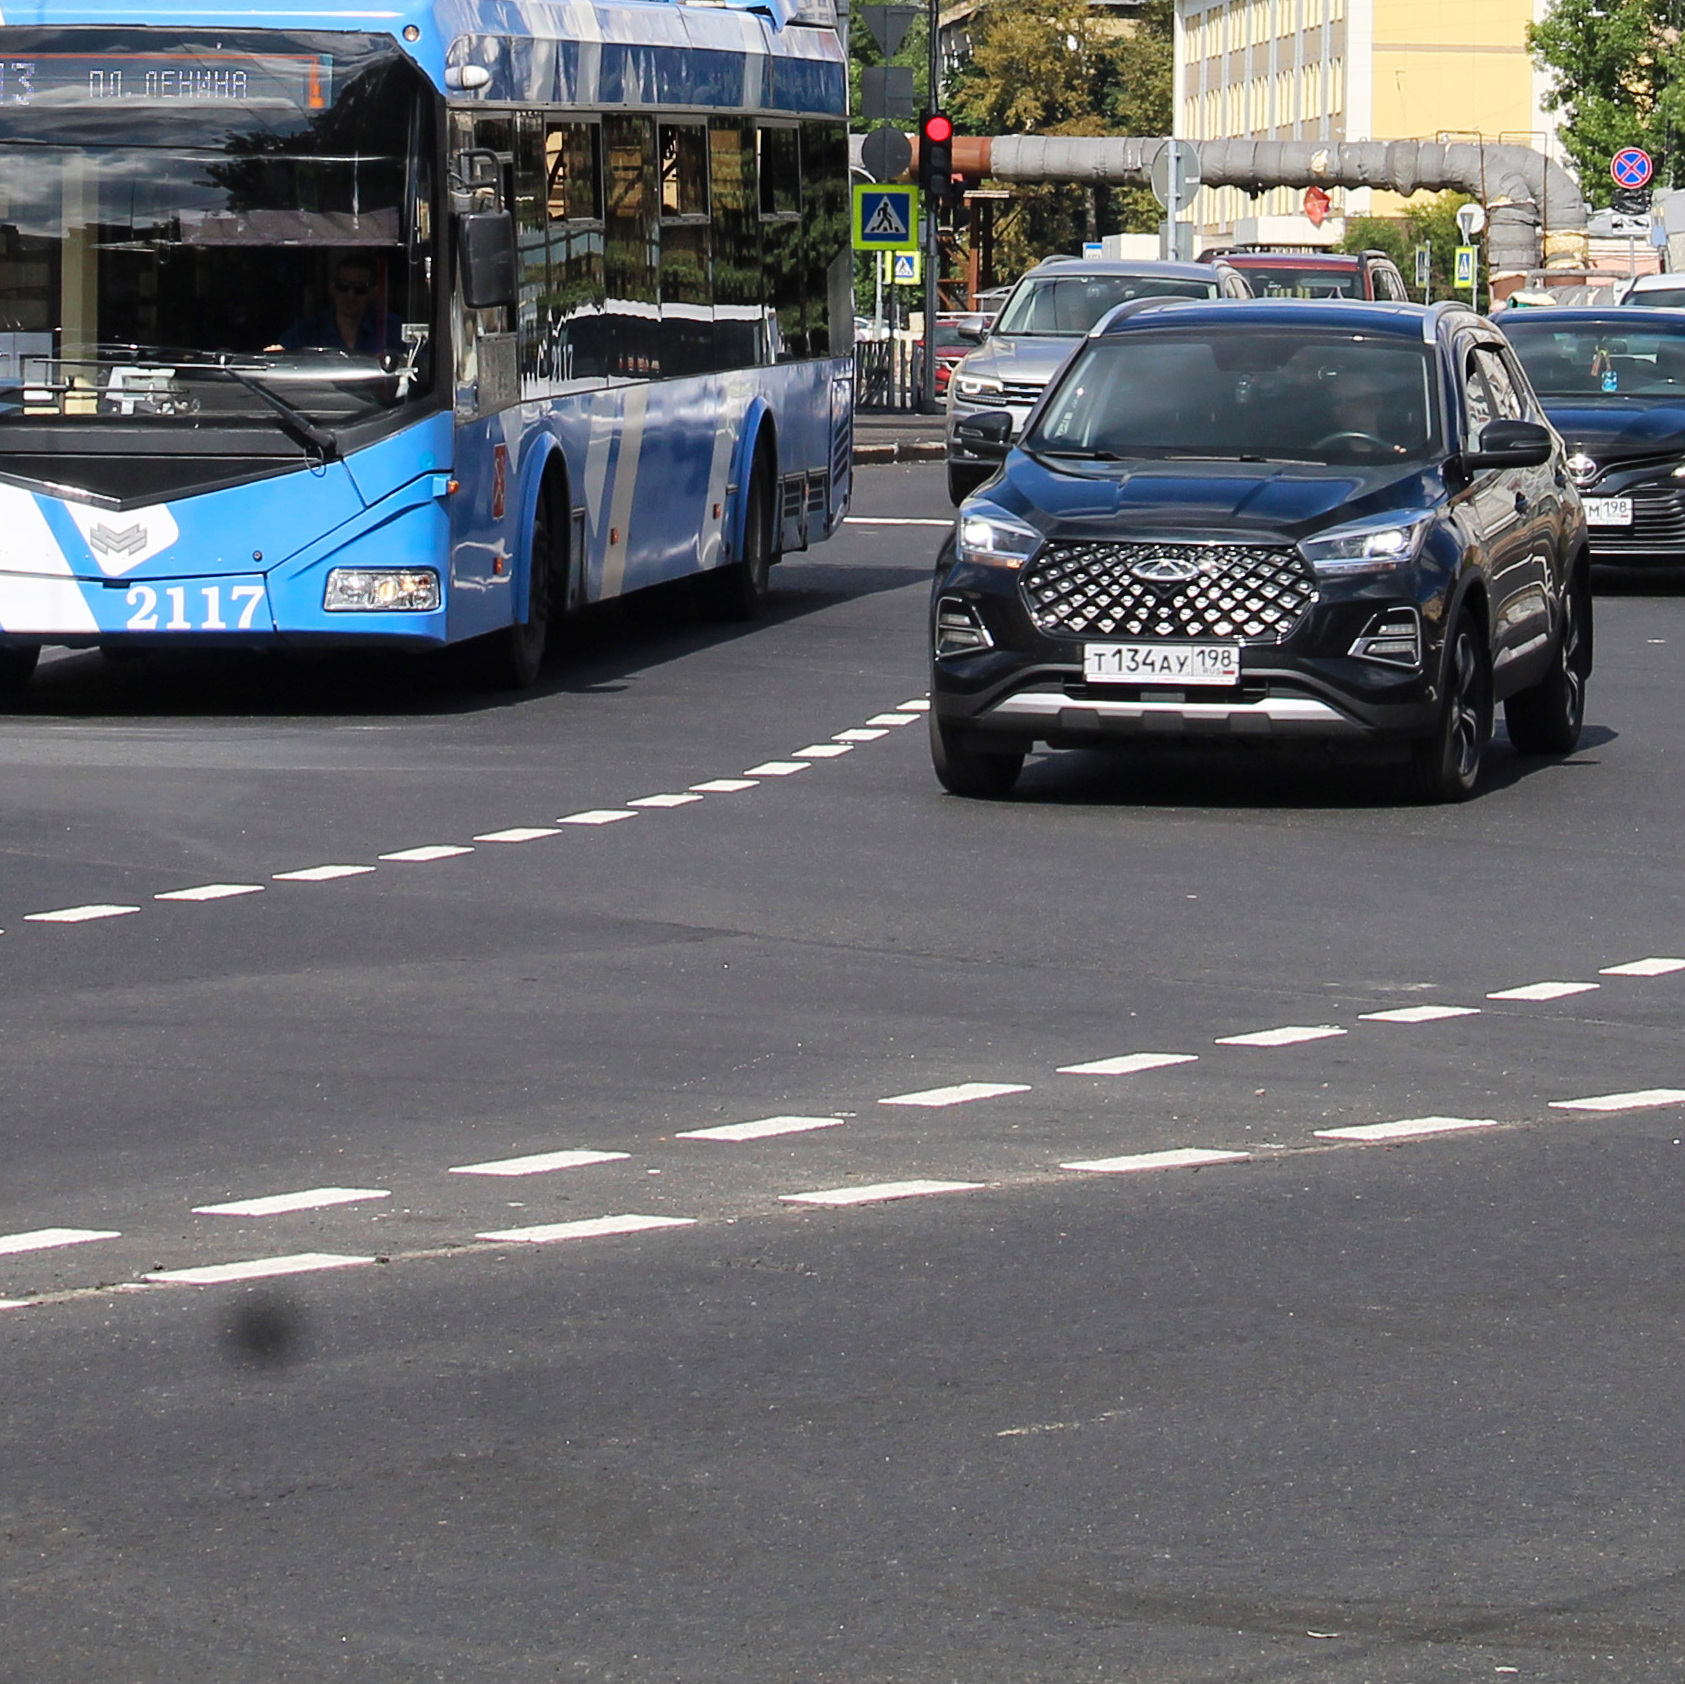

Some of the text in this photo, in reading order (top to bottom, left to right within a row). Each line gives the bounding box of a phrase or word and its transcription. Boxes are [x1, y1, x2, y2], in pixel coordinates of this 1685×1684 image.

[144, 70, 249, 99] ЛЕНИНА
[1603, 500, 1627, 514] 198
[125, 584, 266, 631] 2117
[1093, 648, 1232, 674] Т134АУ 198
